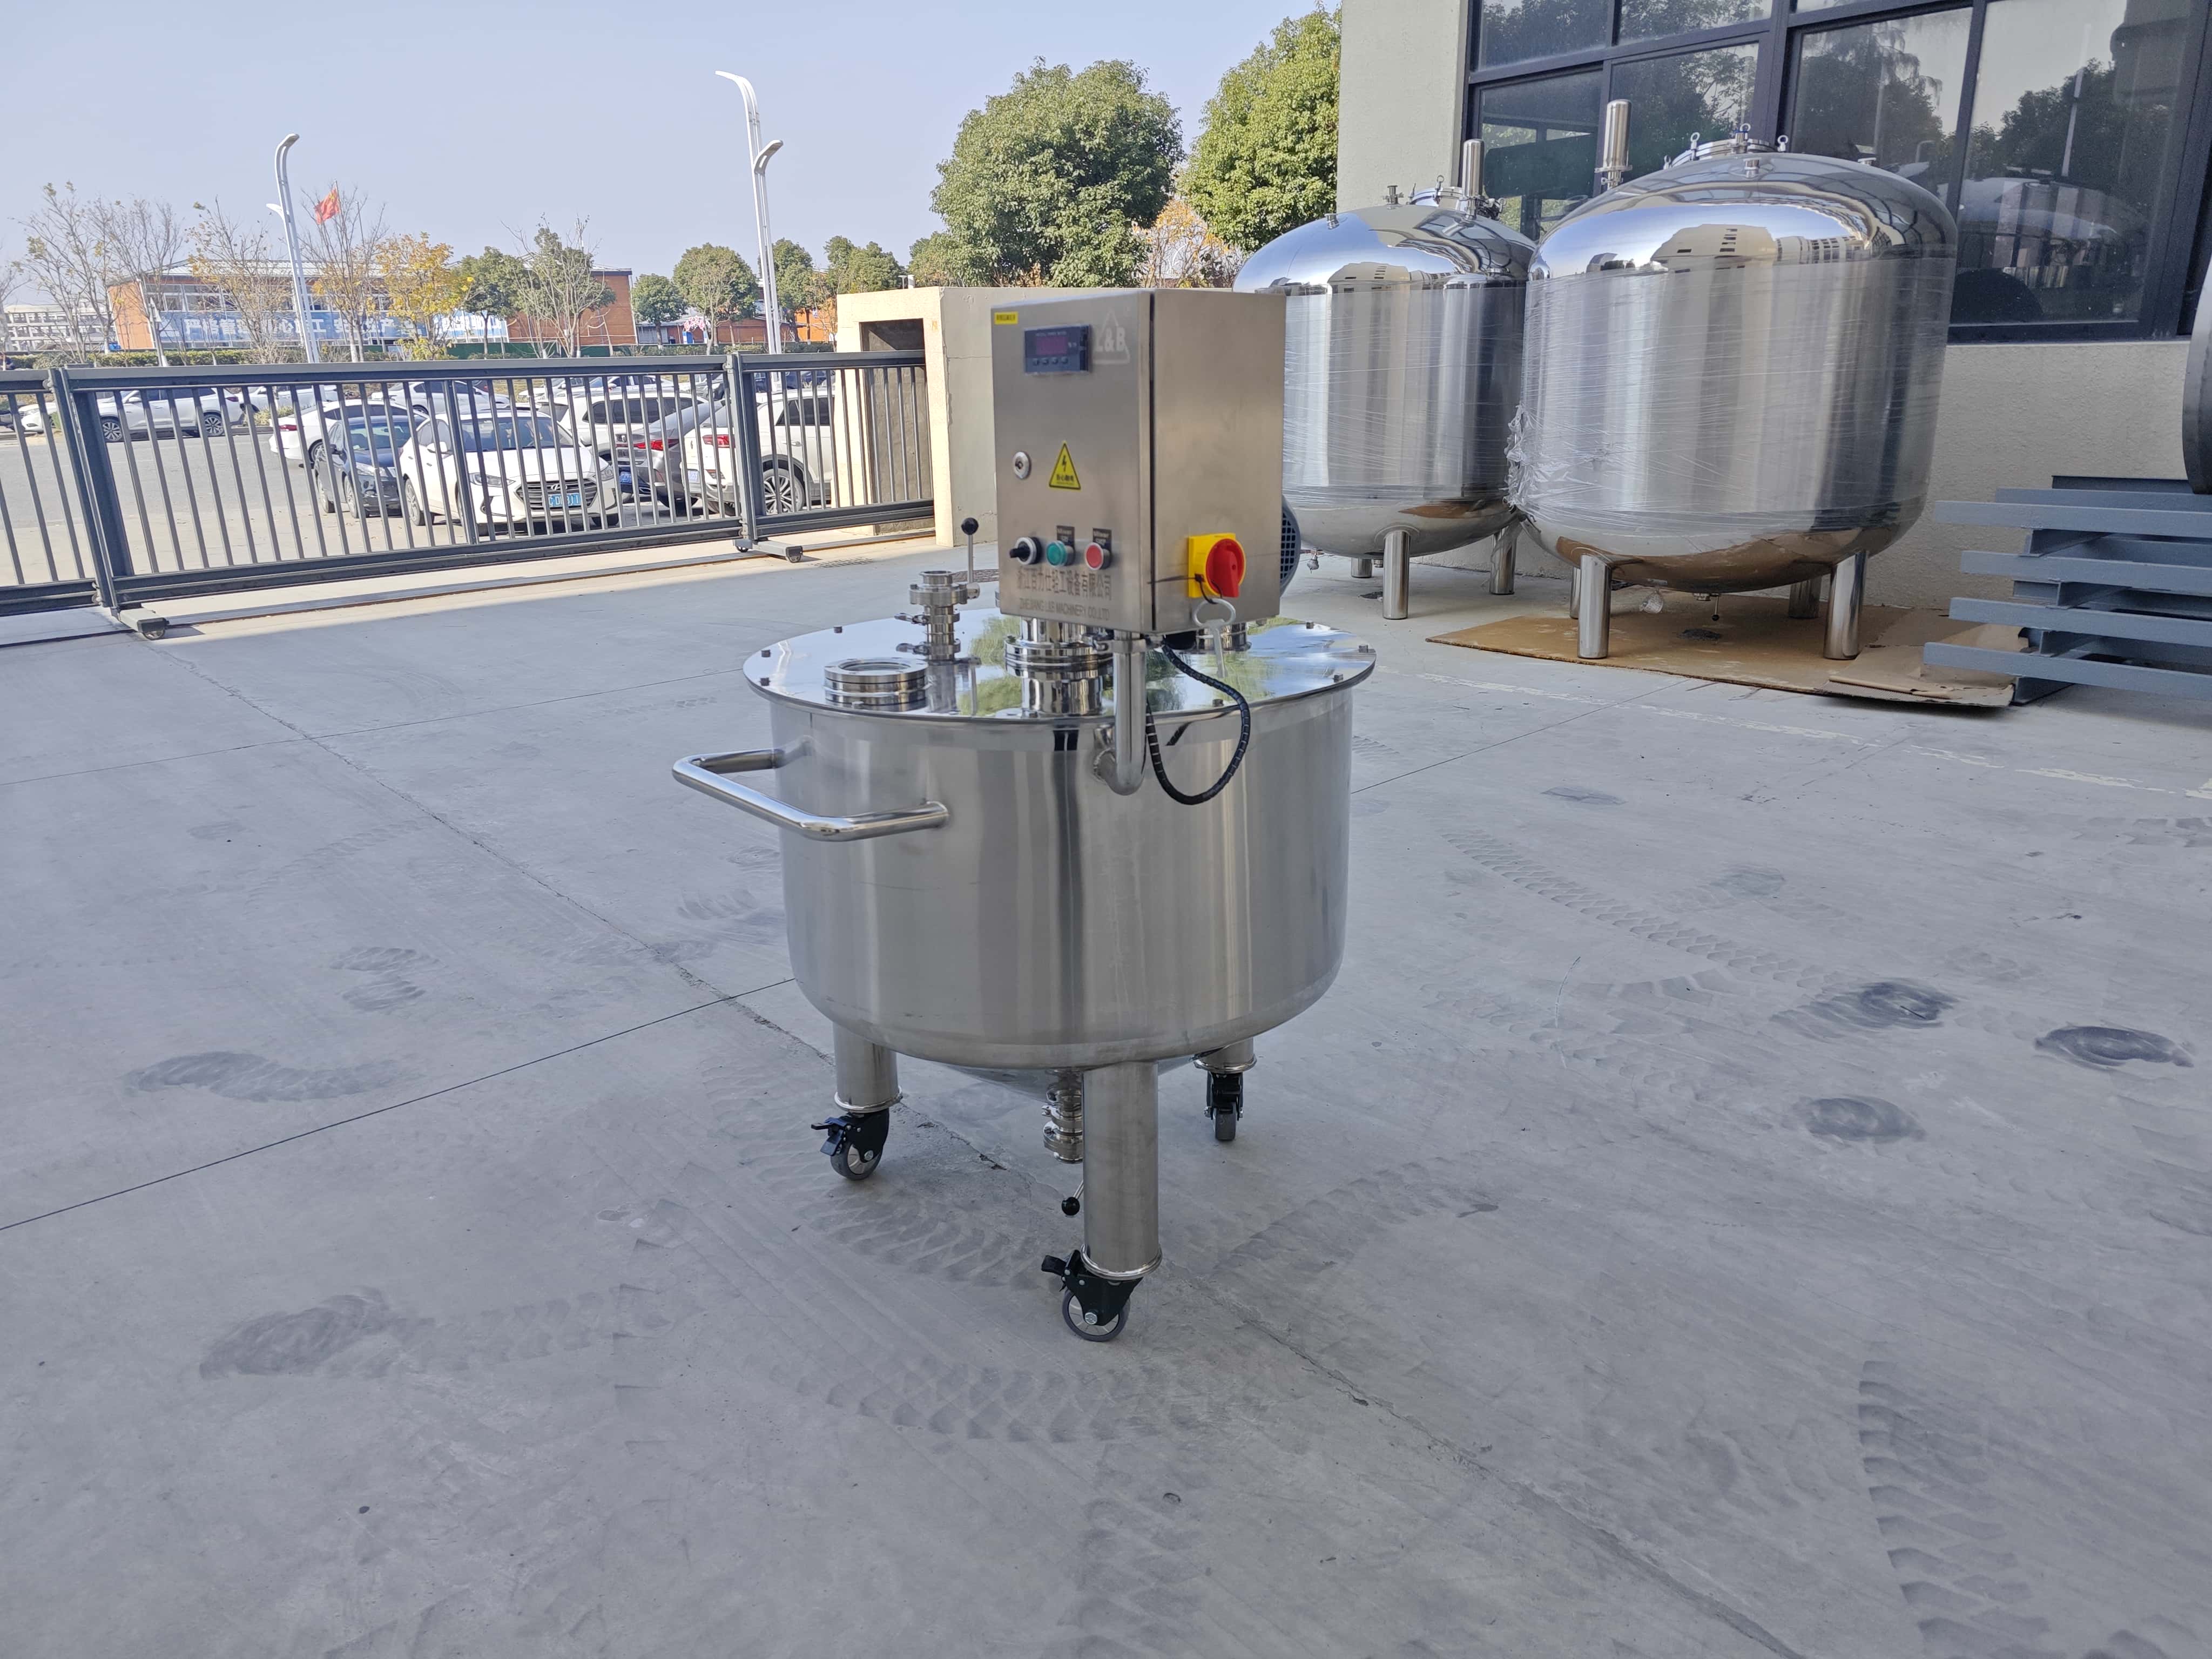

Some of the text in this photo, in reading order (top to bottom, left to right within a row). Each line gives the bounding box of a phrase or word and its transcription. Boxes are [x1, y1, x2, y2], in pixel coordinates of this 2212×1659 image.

[1097, 326, 1127, 352] L&B
[1019, 598, 1044, 611] ZHEJIANG
[1056, 602, 1087, 617] MACHINERY
